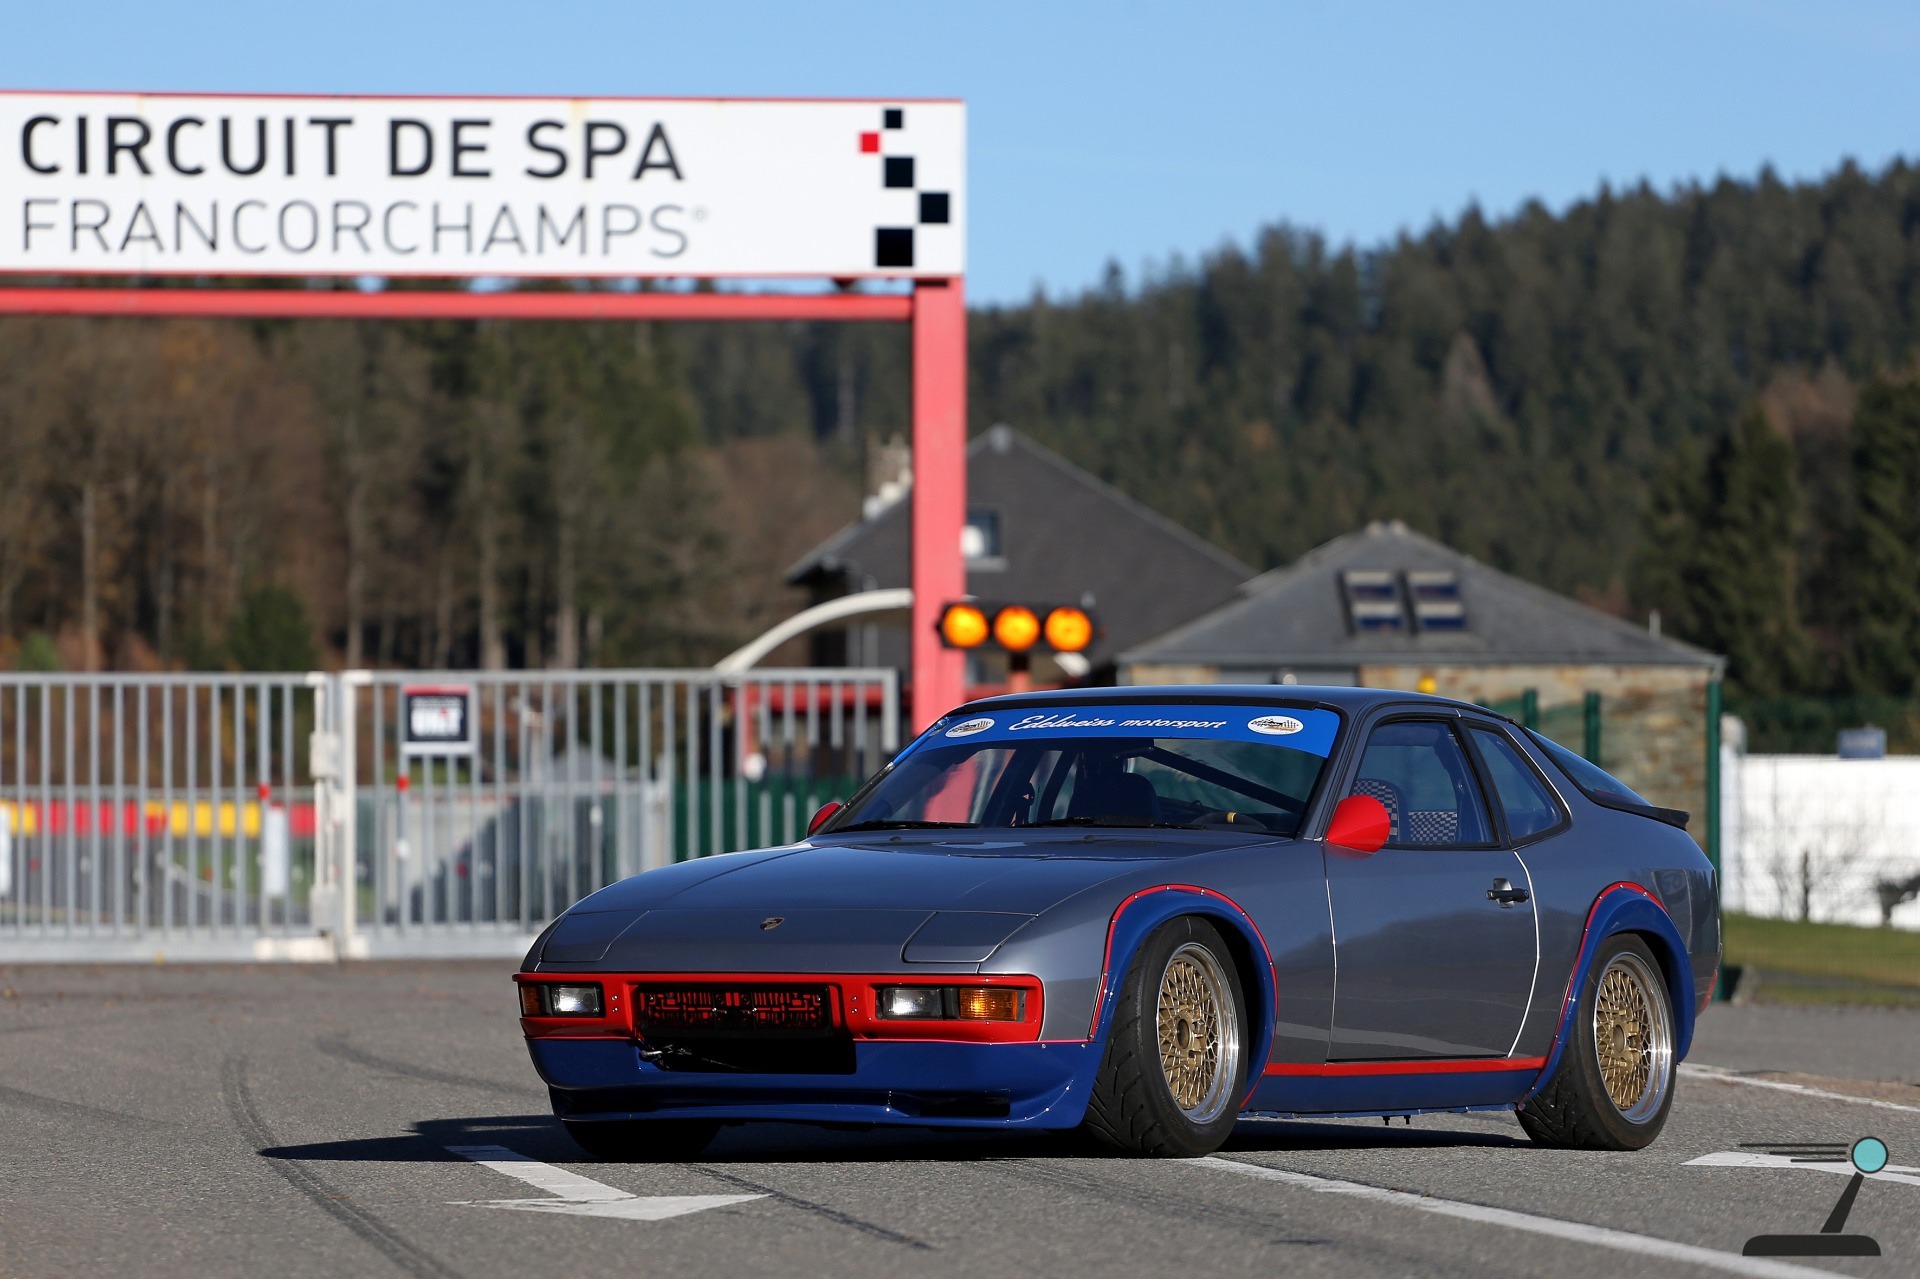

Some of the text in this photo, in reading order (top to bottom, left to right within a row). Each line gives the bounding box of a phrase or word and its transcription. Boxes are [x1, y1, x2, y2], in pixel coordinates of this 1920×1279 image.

[21, 115, 684, 181] CIRCUIT DE SPA
[1009, 713, 1115, 731] Edelweiss
[1118, 718, 1227, 729] motorsport
